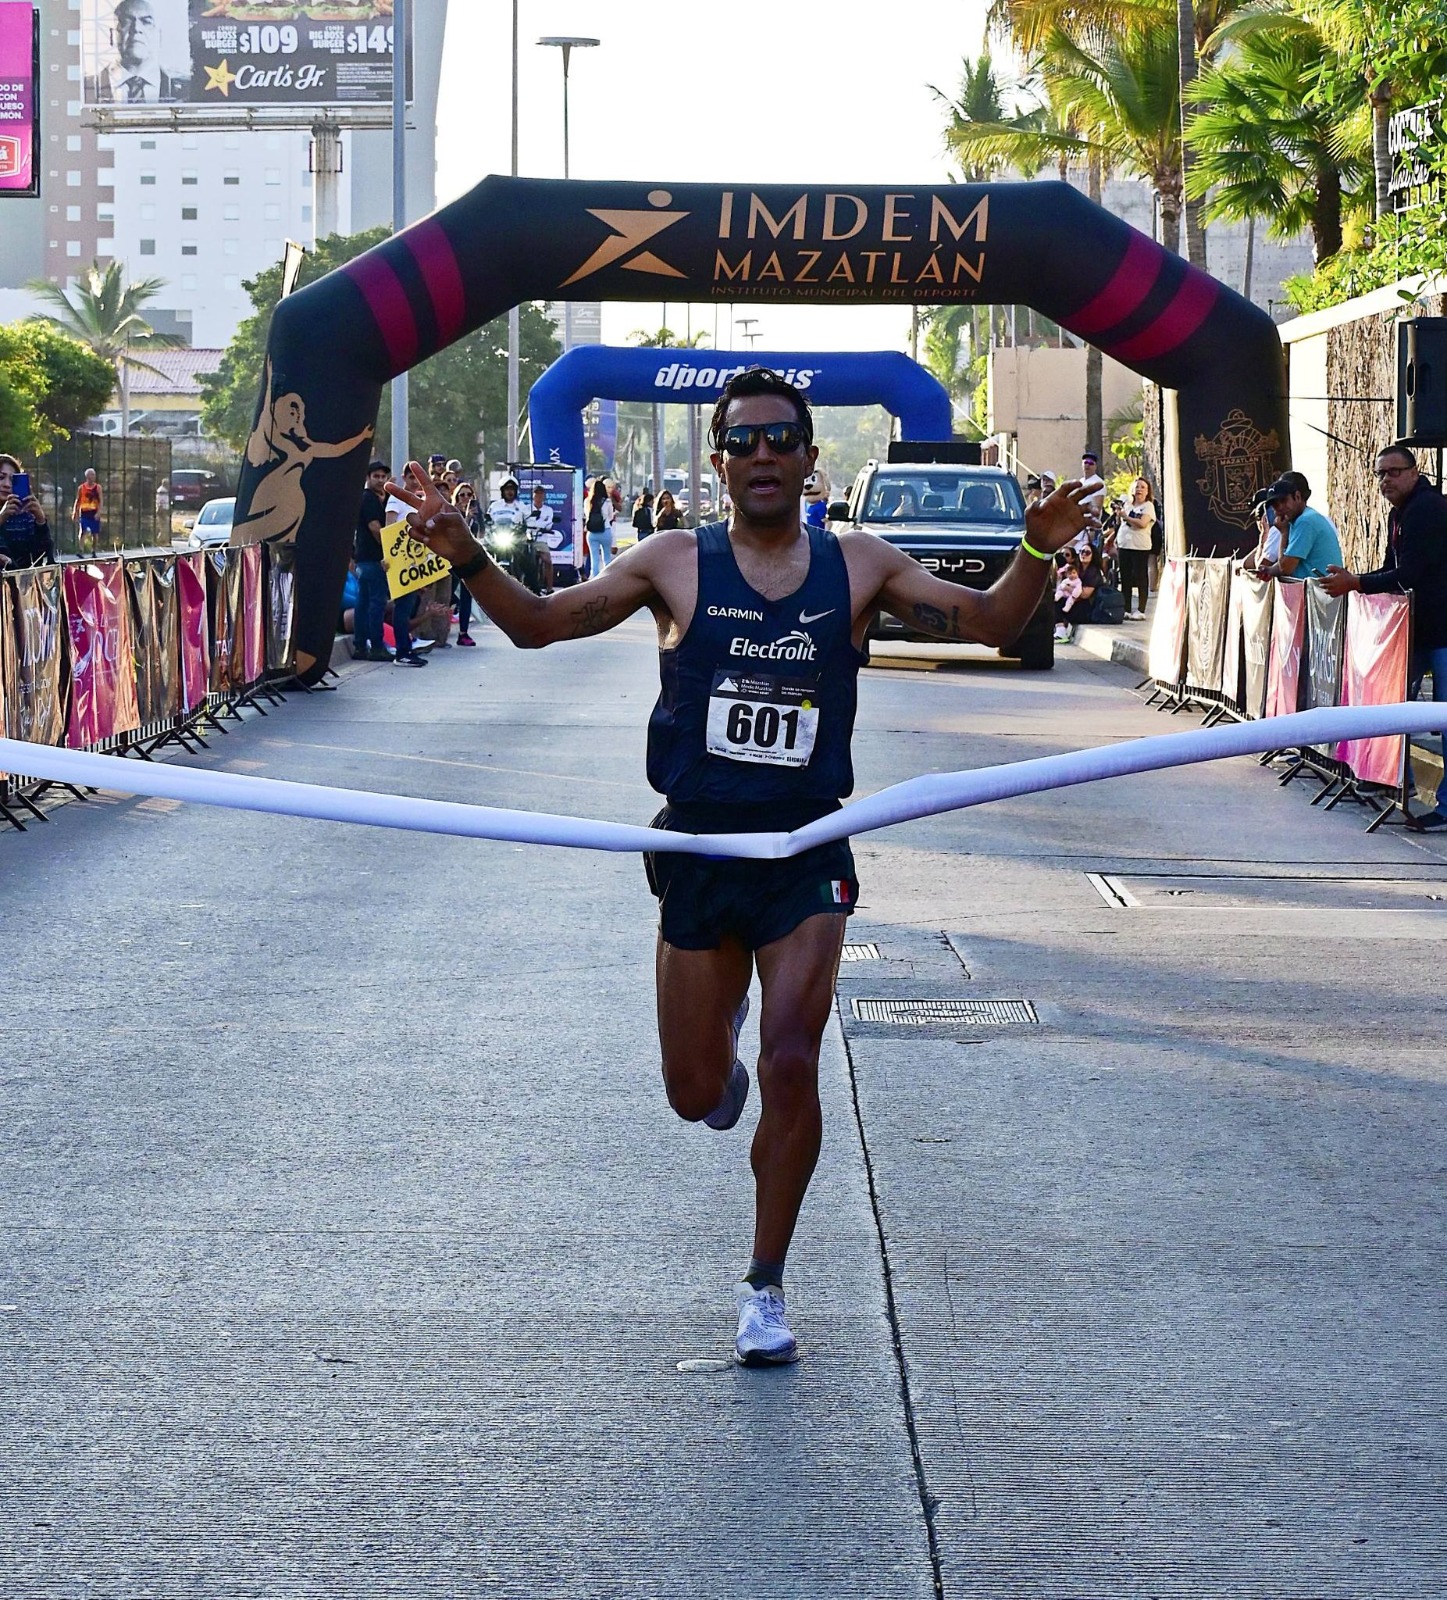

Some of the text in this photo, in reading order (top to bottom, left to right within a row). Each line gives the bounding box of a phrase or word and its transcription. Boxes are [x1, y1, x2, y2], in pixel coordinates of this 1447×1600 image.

[201, 31, 238, 40] BIG BOSS
[240, 25, 298, 53] $109
[309, 31, 345, 40] BIG BOSS
[205, 40, 238, 49] BURGER
[312, 40, 345, 48] BURGER
[234, 64, 294, 89] Carl's
[294, 64, 324, 90] Jr.
[0, 102, 24, 110] UESO
[718, 192, 989, 242] IMDEM
[713, 243, 985, 284] MAZATLÁN
[711, 286, 979, 297] INSTITUTO MUNICIPAL DEL DEPORTE
[399, 555, 445, 586] CORRE
[920, 558, 985, 572] BYD
[707, 606, 763, 621] GARMIN
[729, 636, 817, 661] Electrolit
[726, 703, 799, 750] 601
